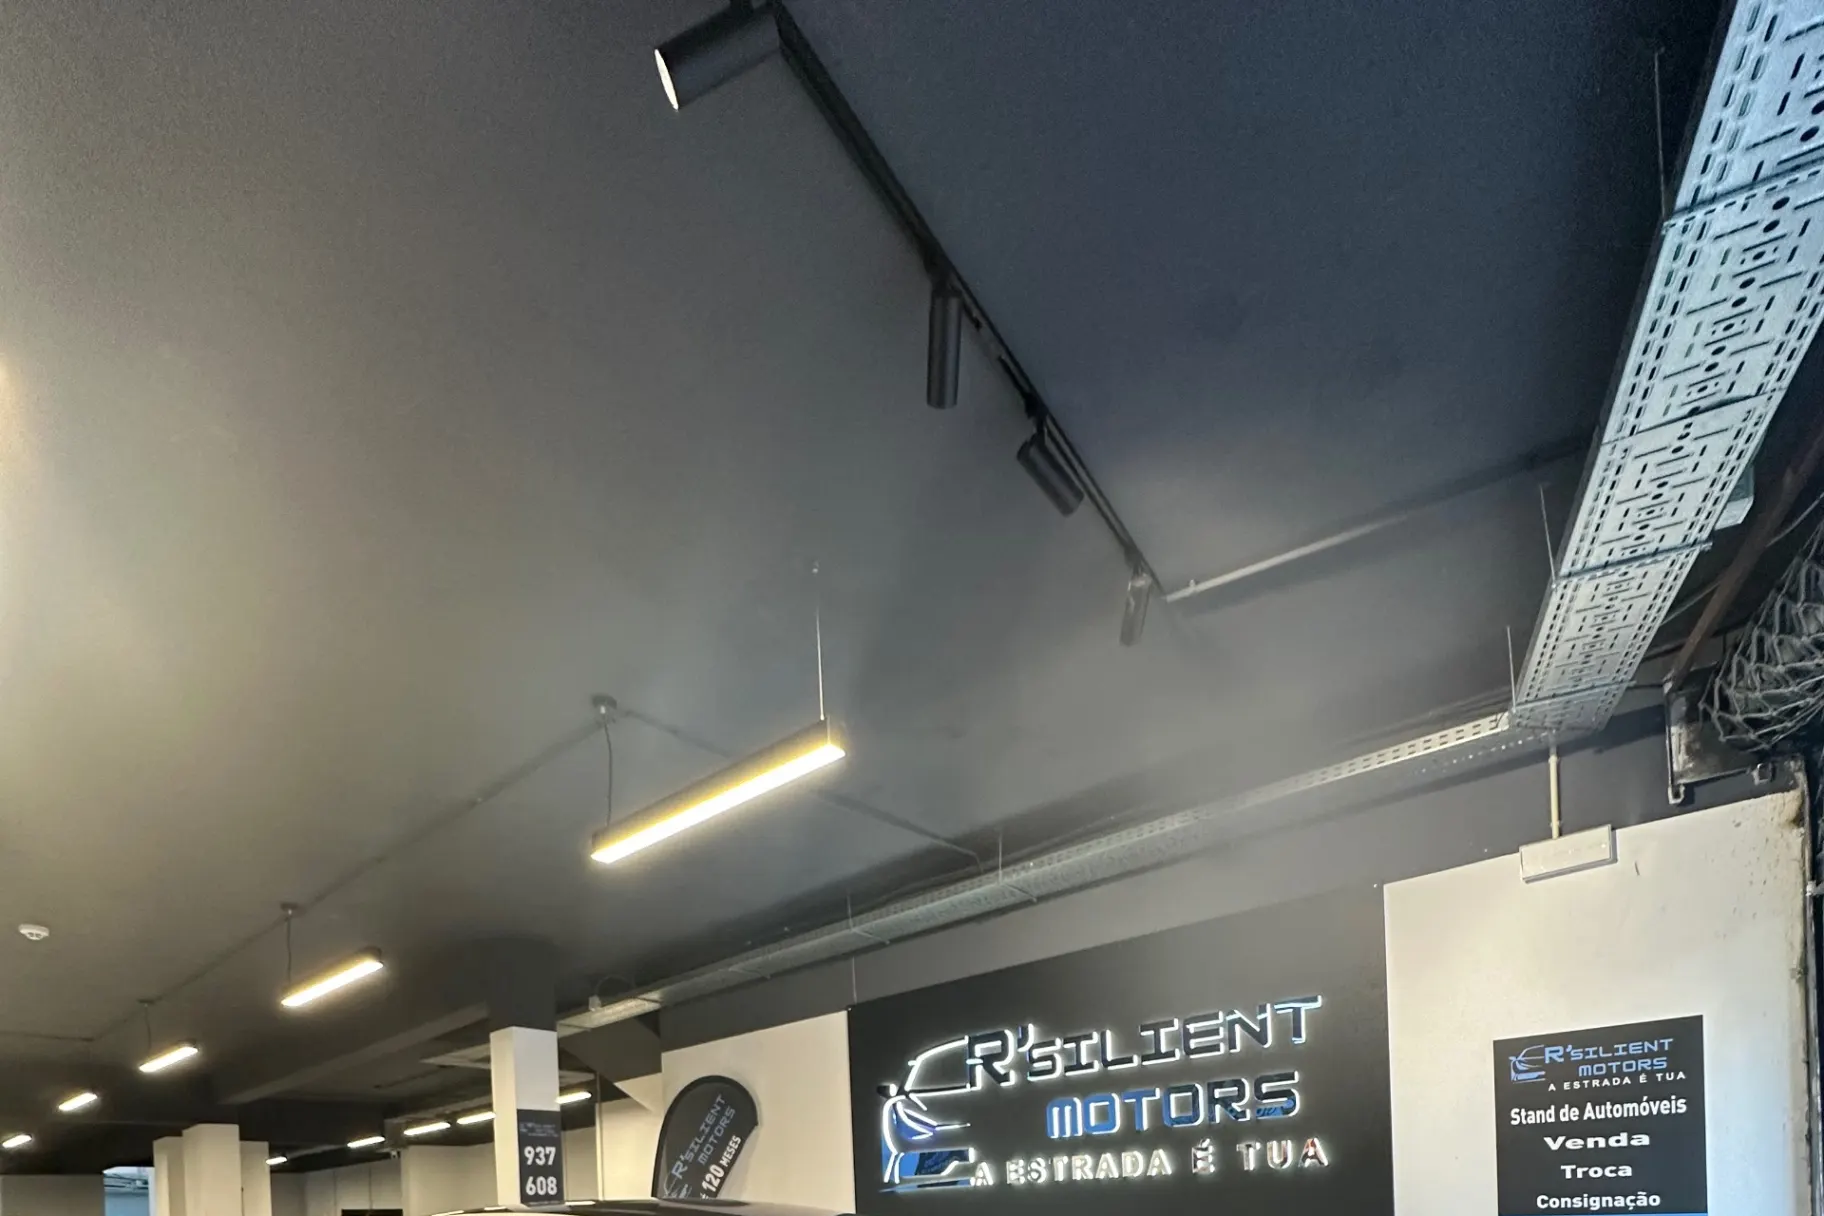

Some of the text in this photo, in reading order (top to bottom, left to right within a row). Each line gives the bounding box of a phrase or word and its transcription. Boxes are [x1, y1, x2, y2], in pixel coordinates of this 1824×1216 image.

[1544, 1038, 1674, 1064] R'SILIENT
[1578, 1056, 1668, 1077] MOTORS
[1548, 1071, 1686, 1092] A ESTRADA É TUA
[1045, 1069, 1300, 1139] MOTORS
[1510, 1095, 1688, 1126] Stand de Automóveis
[697, 1105, 736, 1166] MOTORS
[1543, 1132, 1651, 1151] Venda
[524, 1146, 556, 1166] 937
[701, 1134, 742, 1193] 120 MESES
[970, 1136, 1330, 1187] A ESTRADA É TUA
[1560, 1164, 1633, 1179] Troca
[525, 1175, 558, 1196] 608
[1536, 1191, 1661, 1211] Consignação
